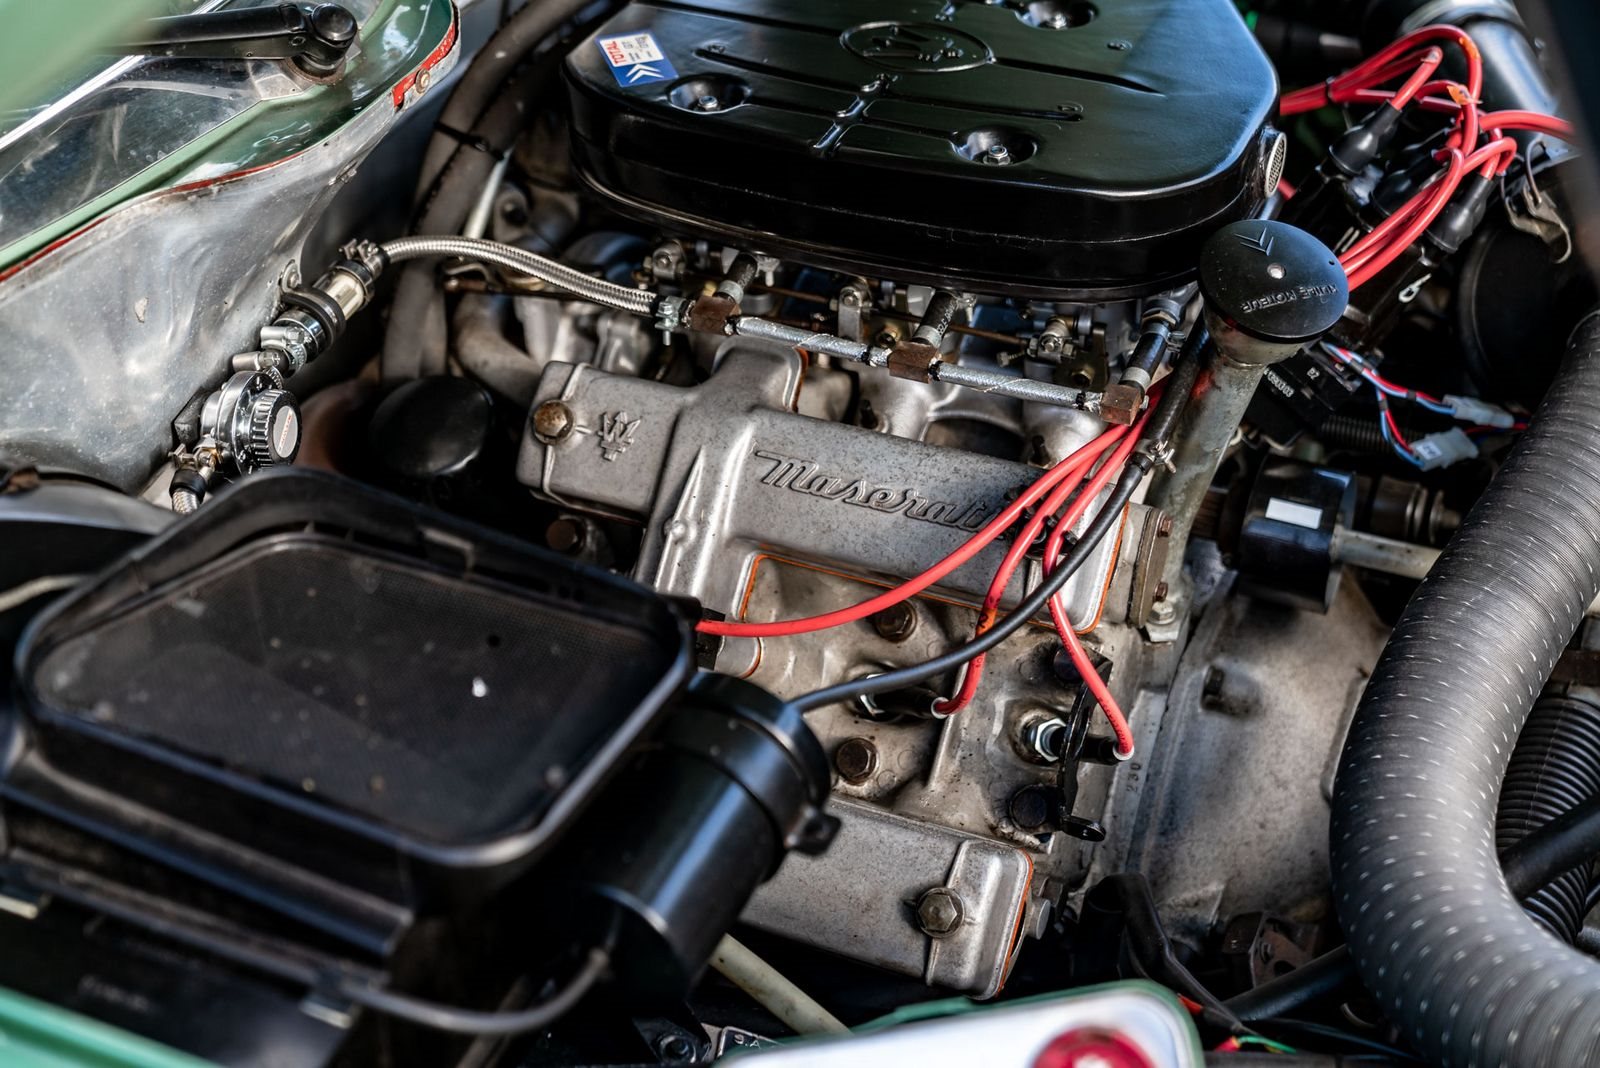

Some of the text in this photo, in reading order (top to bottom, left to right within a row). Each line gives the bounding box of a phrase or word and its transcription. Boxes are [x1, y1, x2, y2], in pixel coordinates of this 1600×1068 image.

[604, 40, 628, 65] TOTAL
[1240, 284, 1338, 314] HUILE MOTEUR
[755, 449, 1000, 533] Maserat
